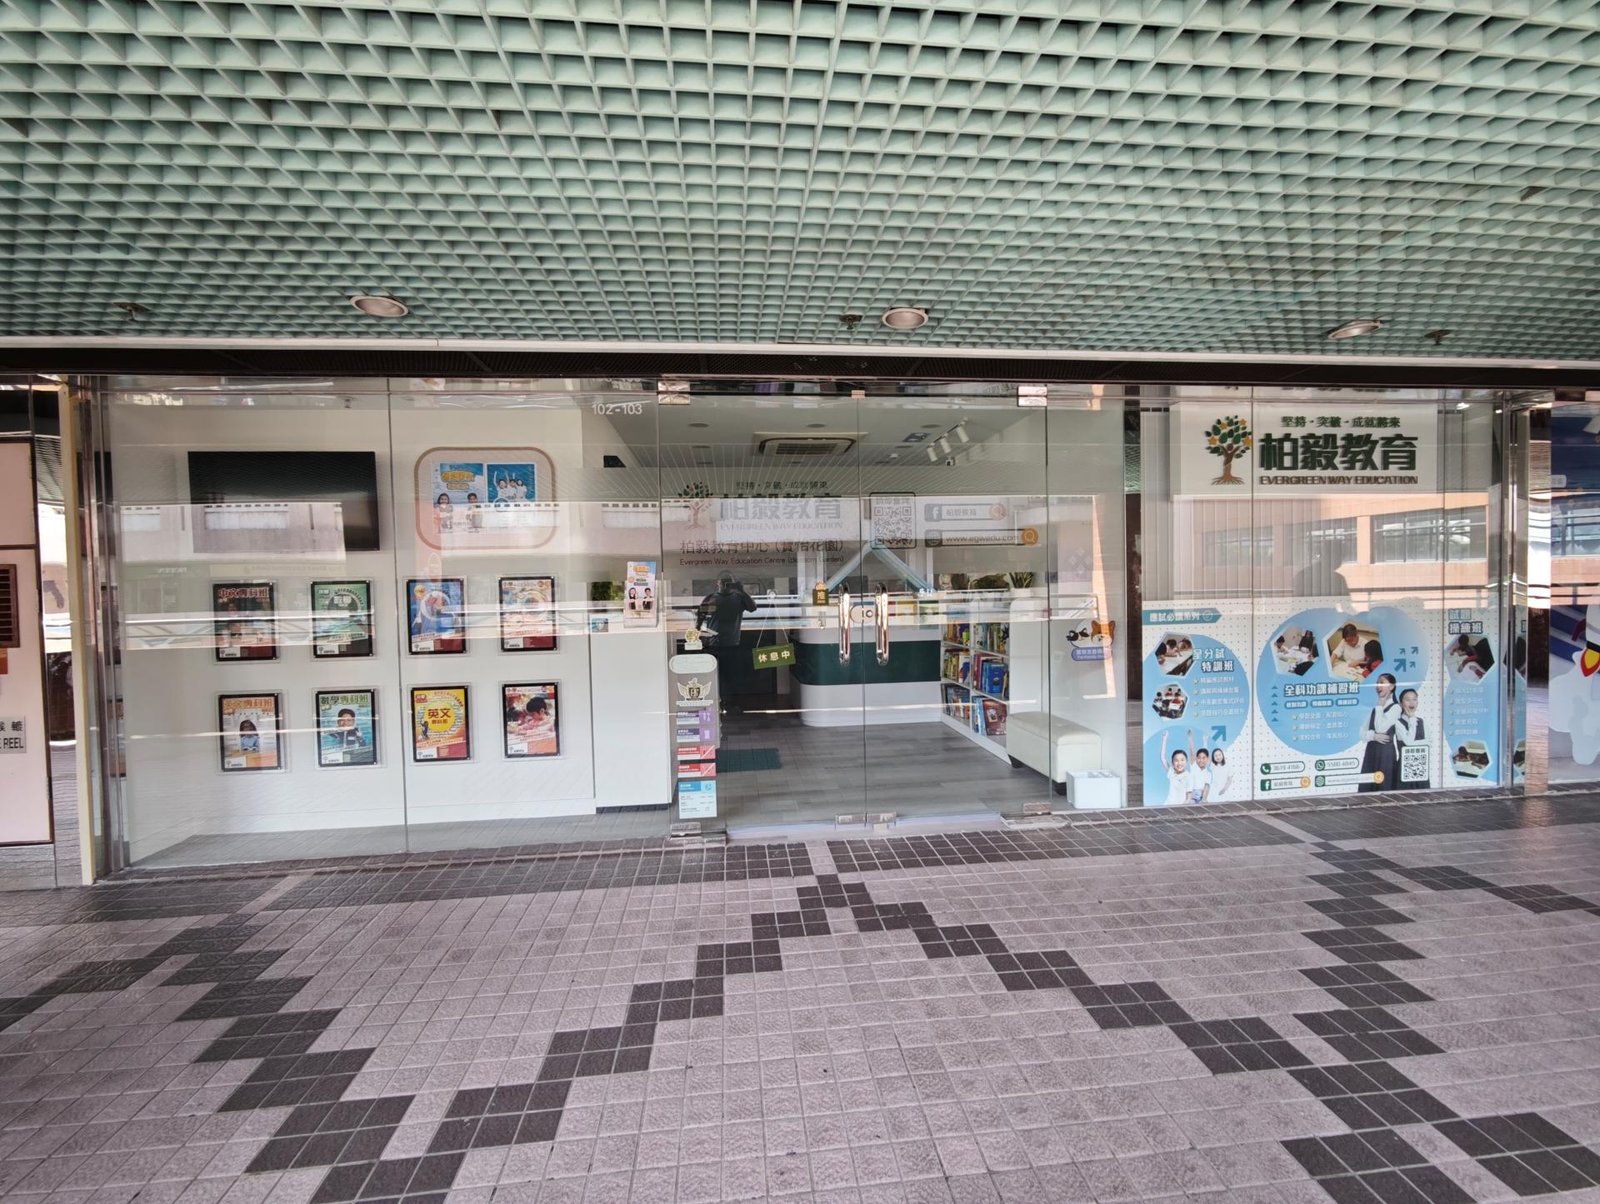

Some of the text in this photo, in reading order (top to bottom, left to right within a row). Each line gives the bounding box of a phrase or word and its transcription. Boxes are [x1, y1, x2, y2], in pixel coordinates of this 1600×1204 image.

[592, 403, 642, 415] 102-103
[1258, 433, 1418, 471] 柏毅教育
[1259, 475, 1418, 485] EVERGREEN WAY EDUCATION
[720, 493, 842, 520] 柏毅教育
[720, 522, 843, 531] EVERGREEN WAY EDUCATION
[680, 558, 713, 567] Evergreen
[714, 557, 729, 567] Way
[730, 557, 763, 566] Education
[758, 649, 791, 664] 休息中
[1201, 660, 1234, 673] 特訓班
[1284, 682, 1359, 697] 全科功課補習班
[428, 708, 452, 720] 英文
[3, 737, 24, 749] REEL
